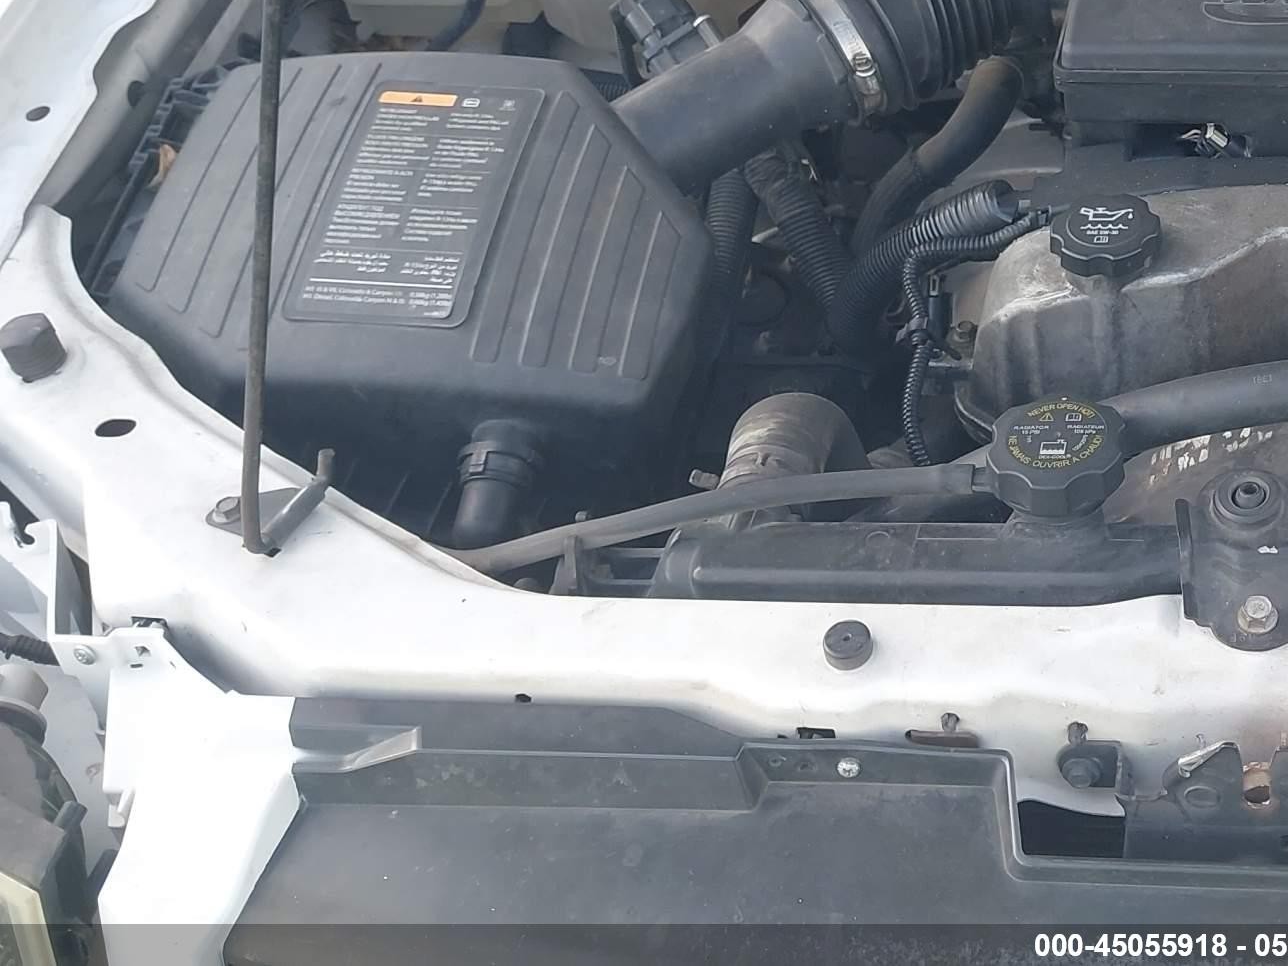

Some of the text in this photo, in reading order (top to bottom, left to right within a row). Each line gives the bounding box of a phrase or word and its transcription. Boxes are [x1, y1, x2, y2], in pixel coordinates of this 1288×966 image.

[1027, 404, 1056, 417] NEVER
[1056, 403, 1079, 411] OPEN
[1032, 459, 1071, 469] OUVRIR
